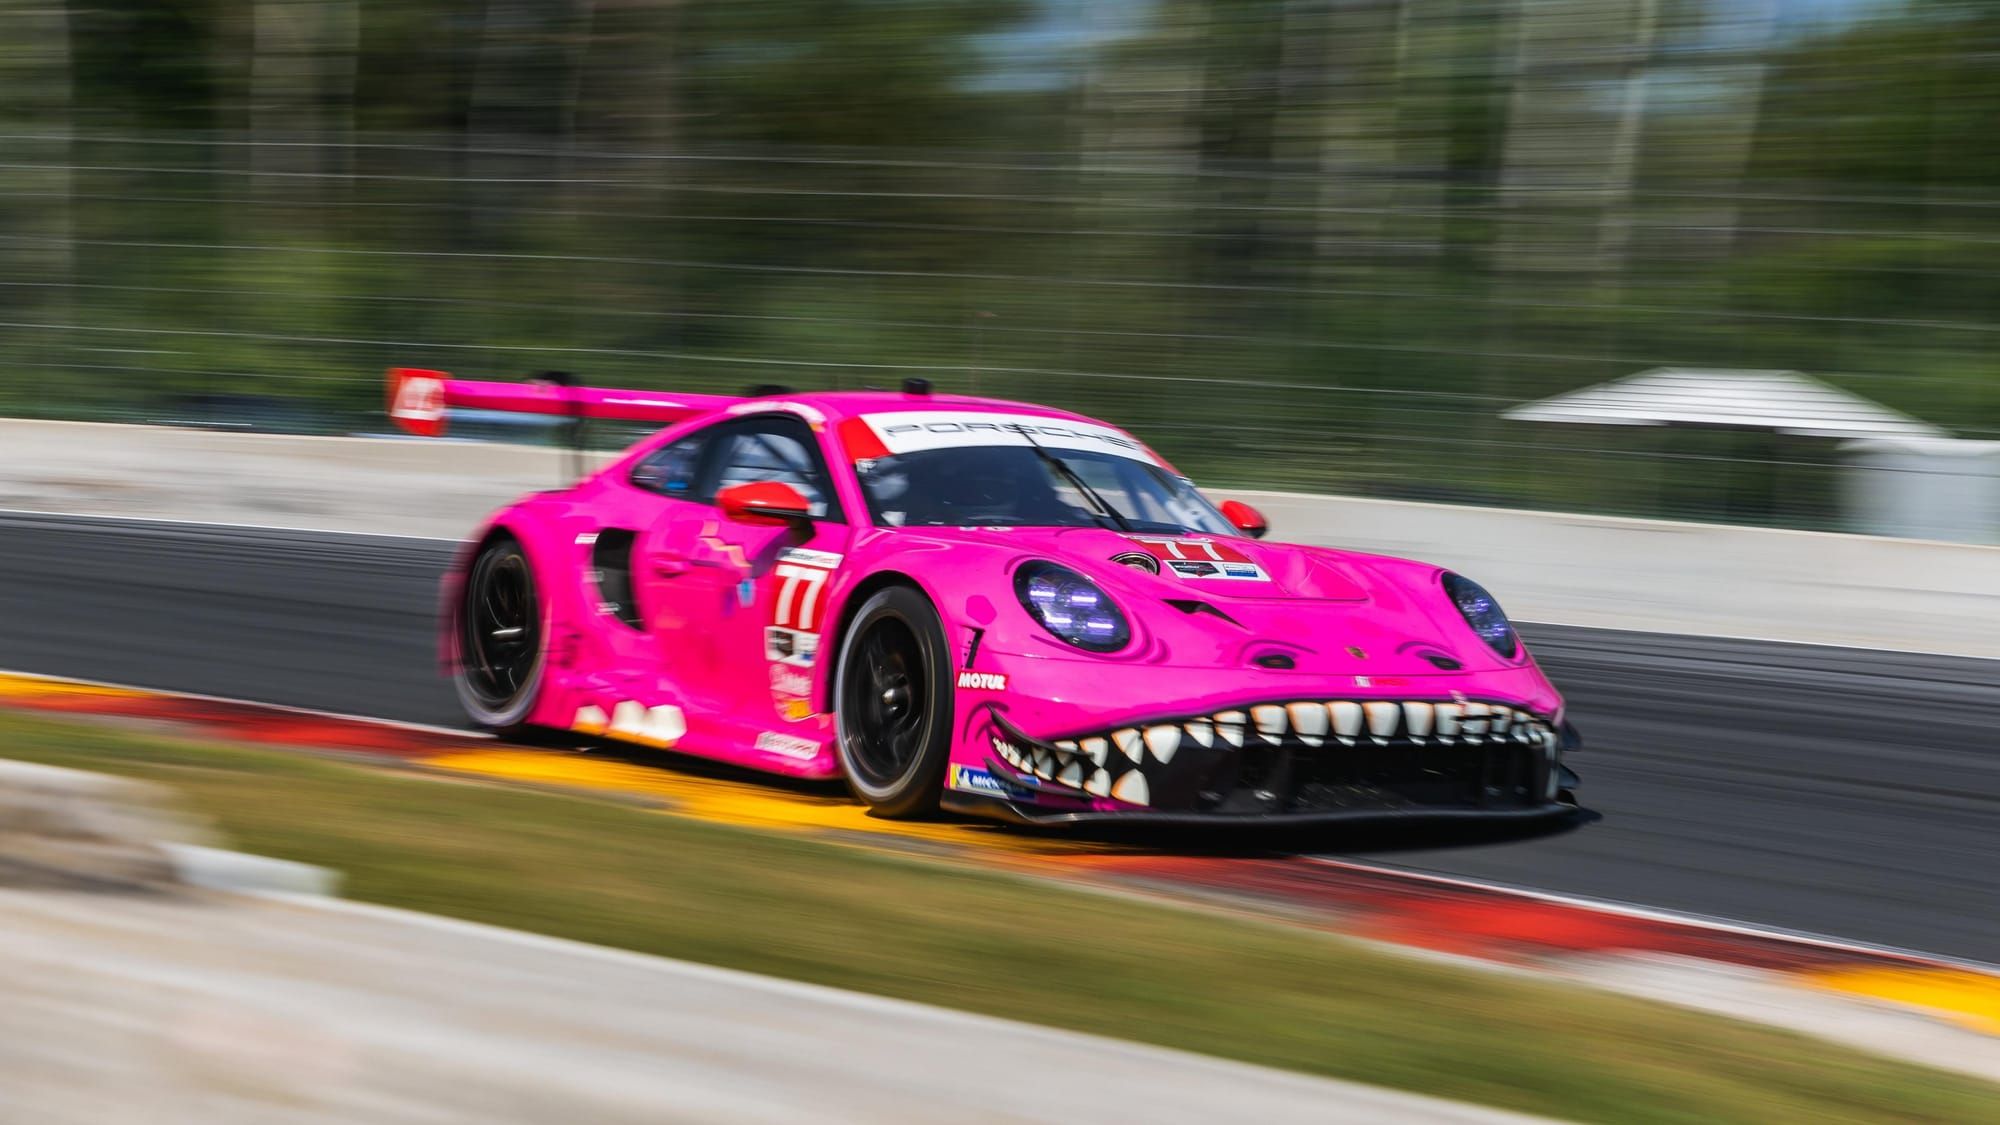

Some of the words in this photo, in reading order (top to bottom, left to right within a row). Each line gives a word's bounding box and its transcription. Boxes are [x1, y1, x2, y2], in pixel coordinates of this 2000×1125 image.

[885, 422, 1138, 450] PORSCHE
[1142, 540, 1225, 560] 77
[775, 565, 828, 629] 77
[958, 672, 1006, 690] MOTUL
